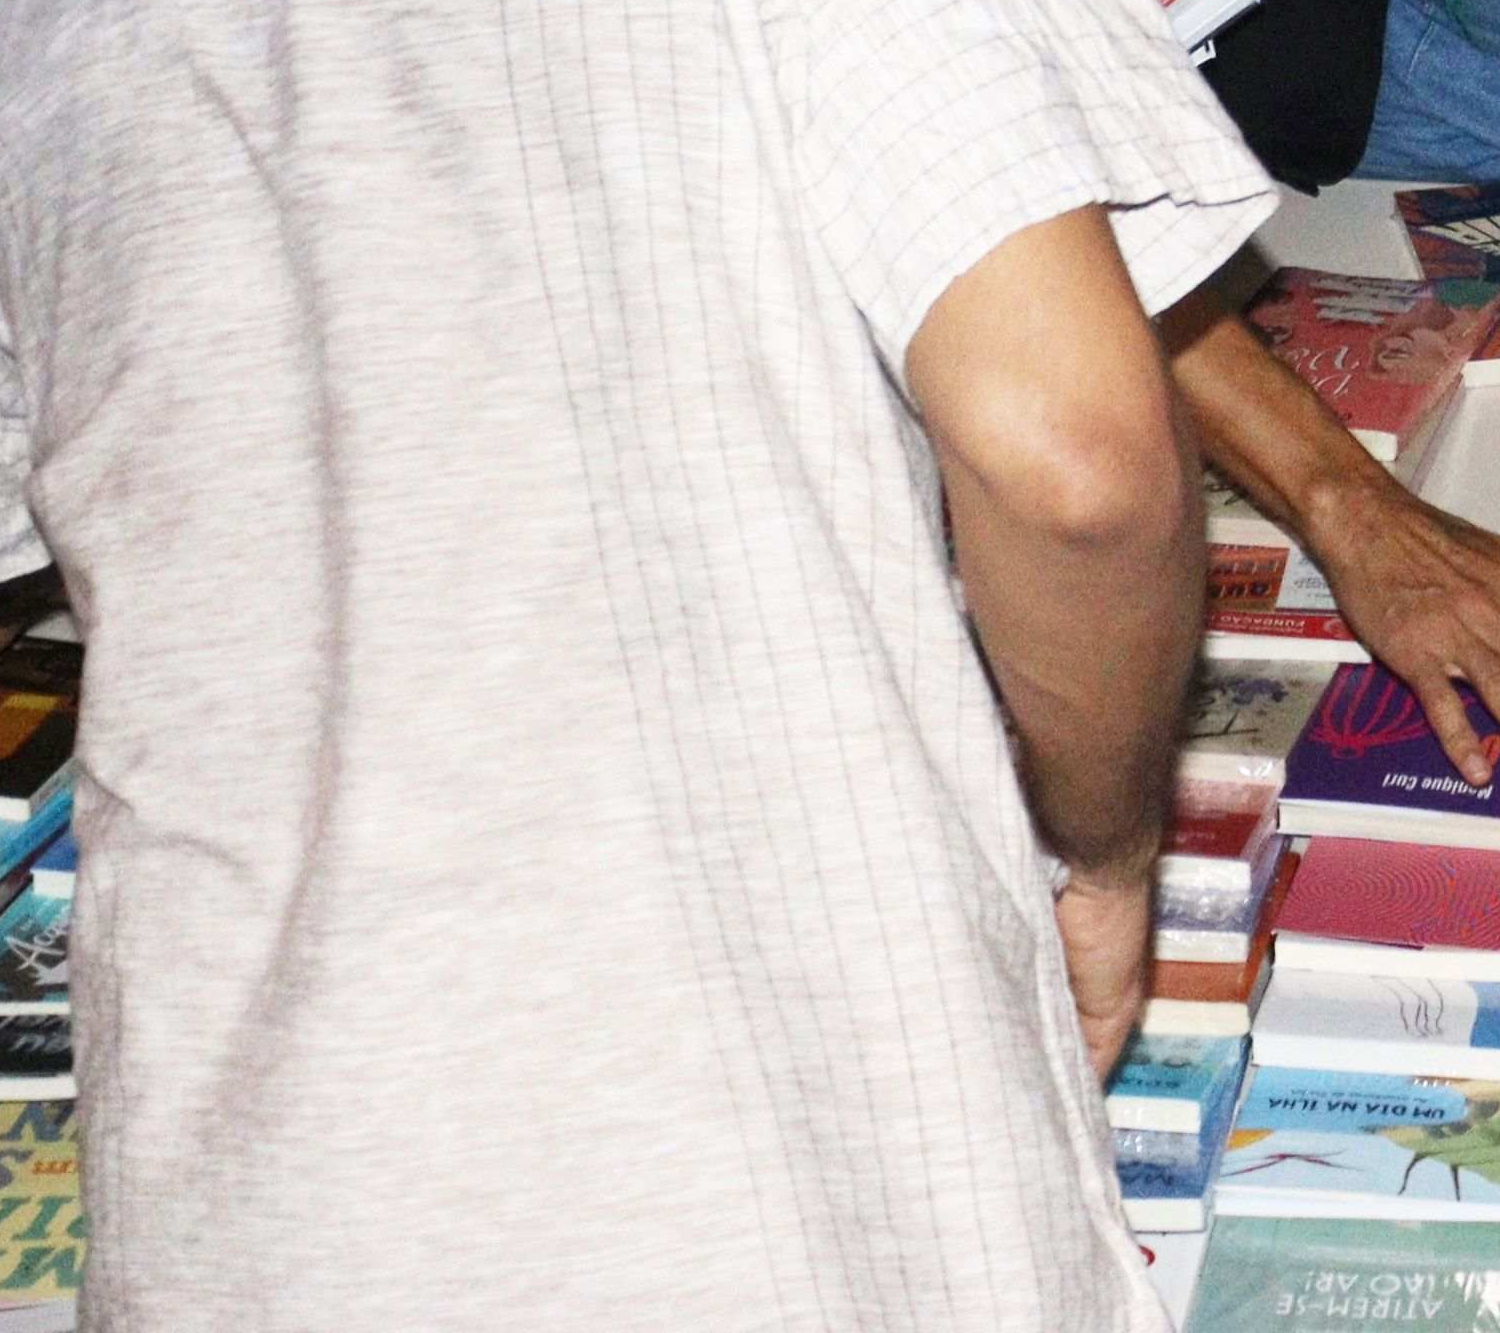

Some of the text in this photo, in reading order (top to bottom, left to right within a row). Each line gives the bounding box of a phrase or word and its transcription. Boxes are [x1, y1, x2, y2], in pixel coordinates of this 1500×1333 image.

[1268, 1097, 1318, 1112] ILHA
[1326, 1099, 1358, 1113] NA
[1365, 1102, 1407, 1118] DIA
[1413, 1106, 1445, 1120] UM
[1304, 1271, 1360, 1293] AR!
[1274, 1292, 1444, 1321] ATIREM-SE
